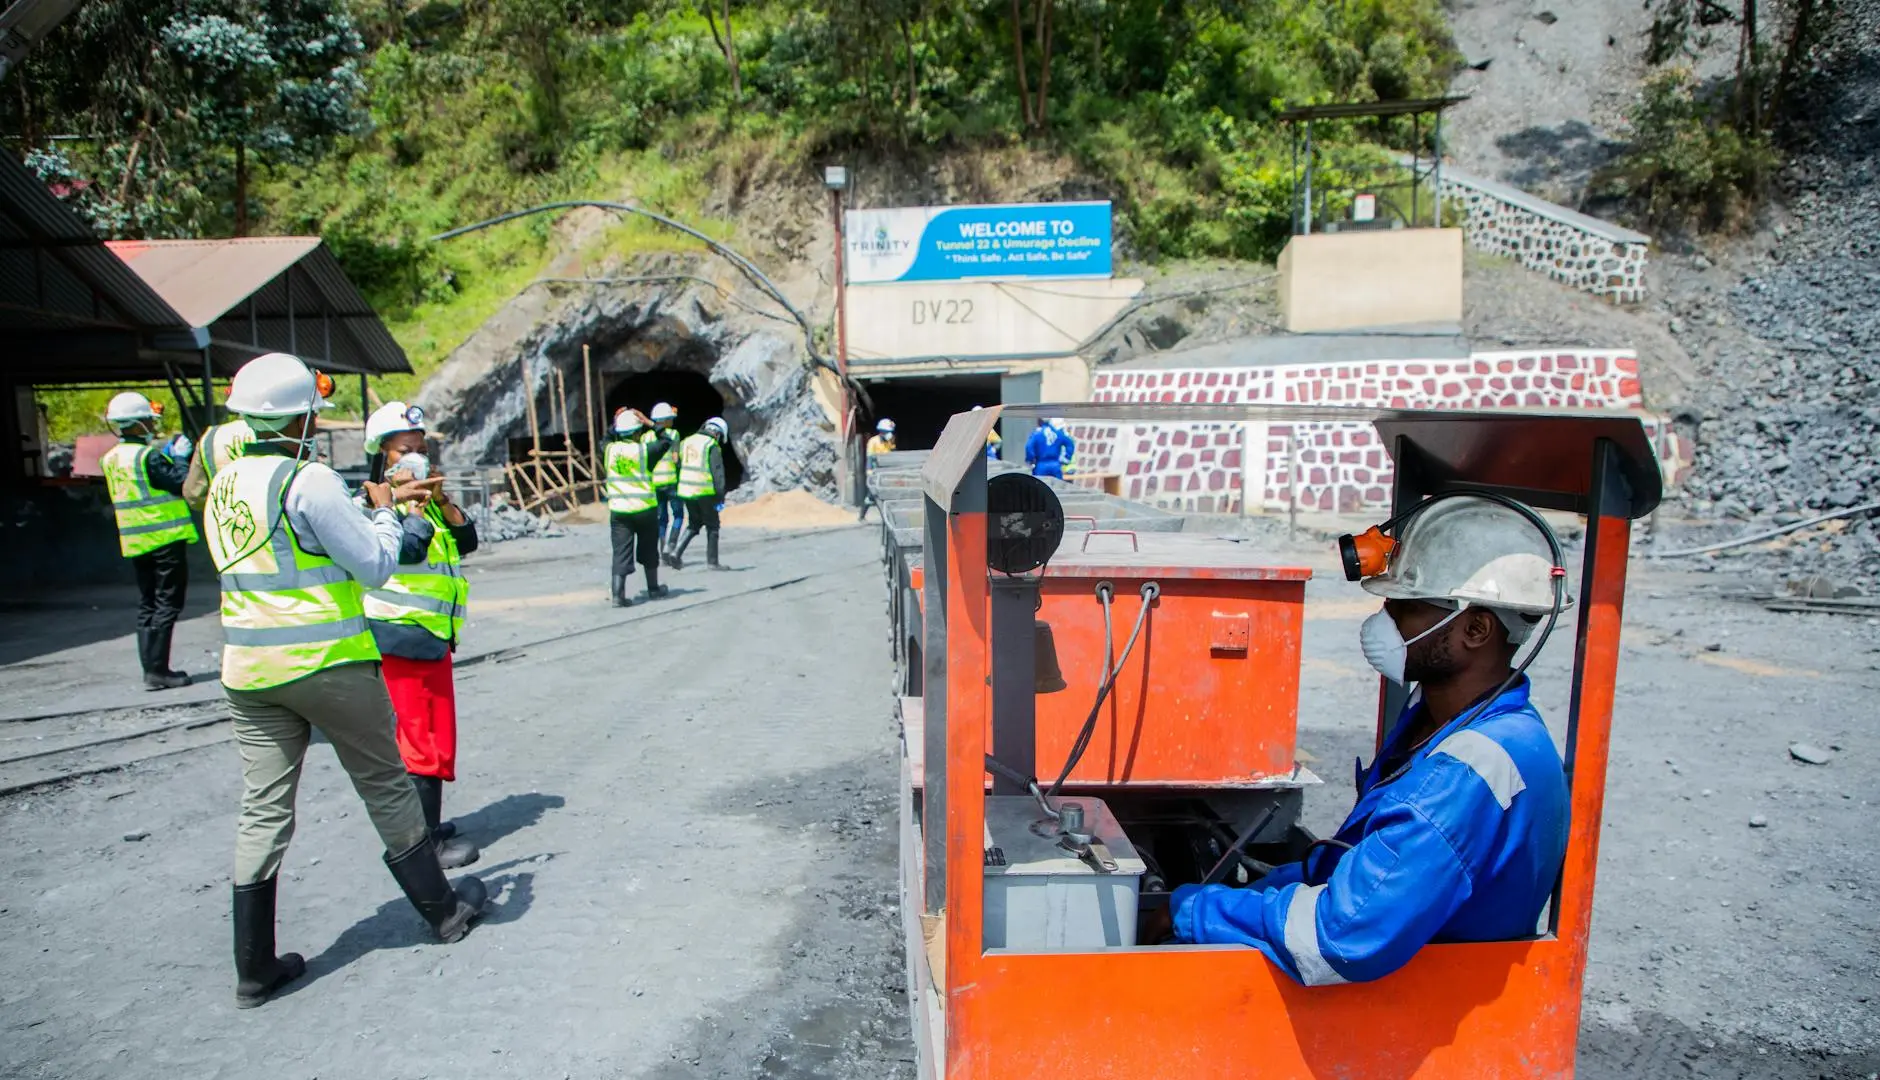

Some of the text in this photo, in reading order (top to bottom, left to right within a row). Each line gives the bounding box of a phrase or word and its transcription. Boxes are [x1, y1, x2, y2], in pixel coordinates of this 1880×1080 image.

[959, 220, 1074, 237] WELCOME TO
[851, 240, 910, 252] TRINITY
[952, 253, 979, 263] Think
